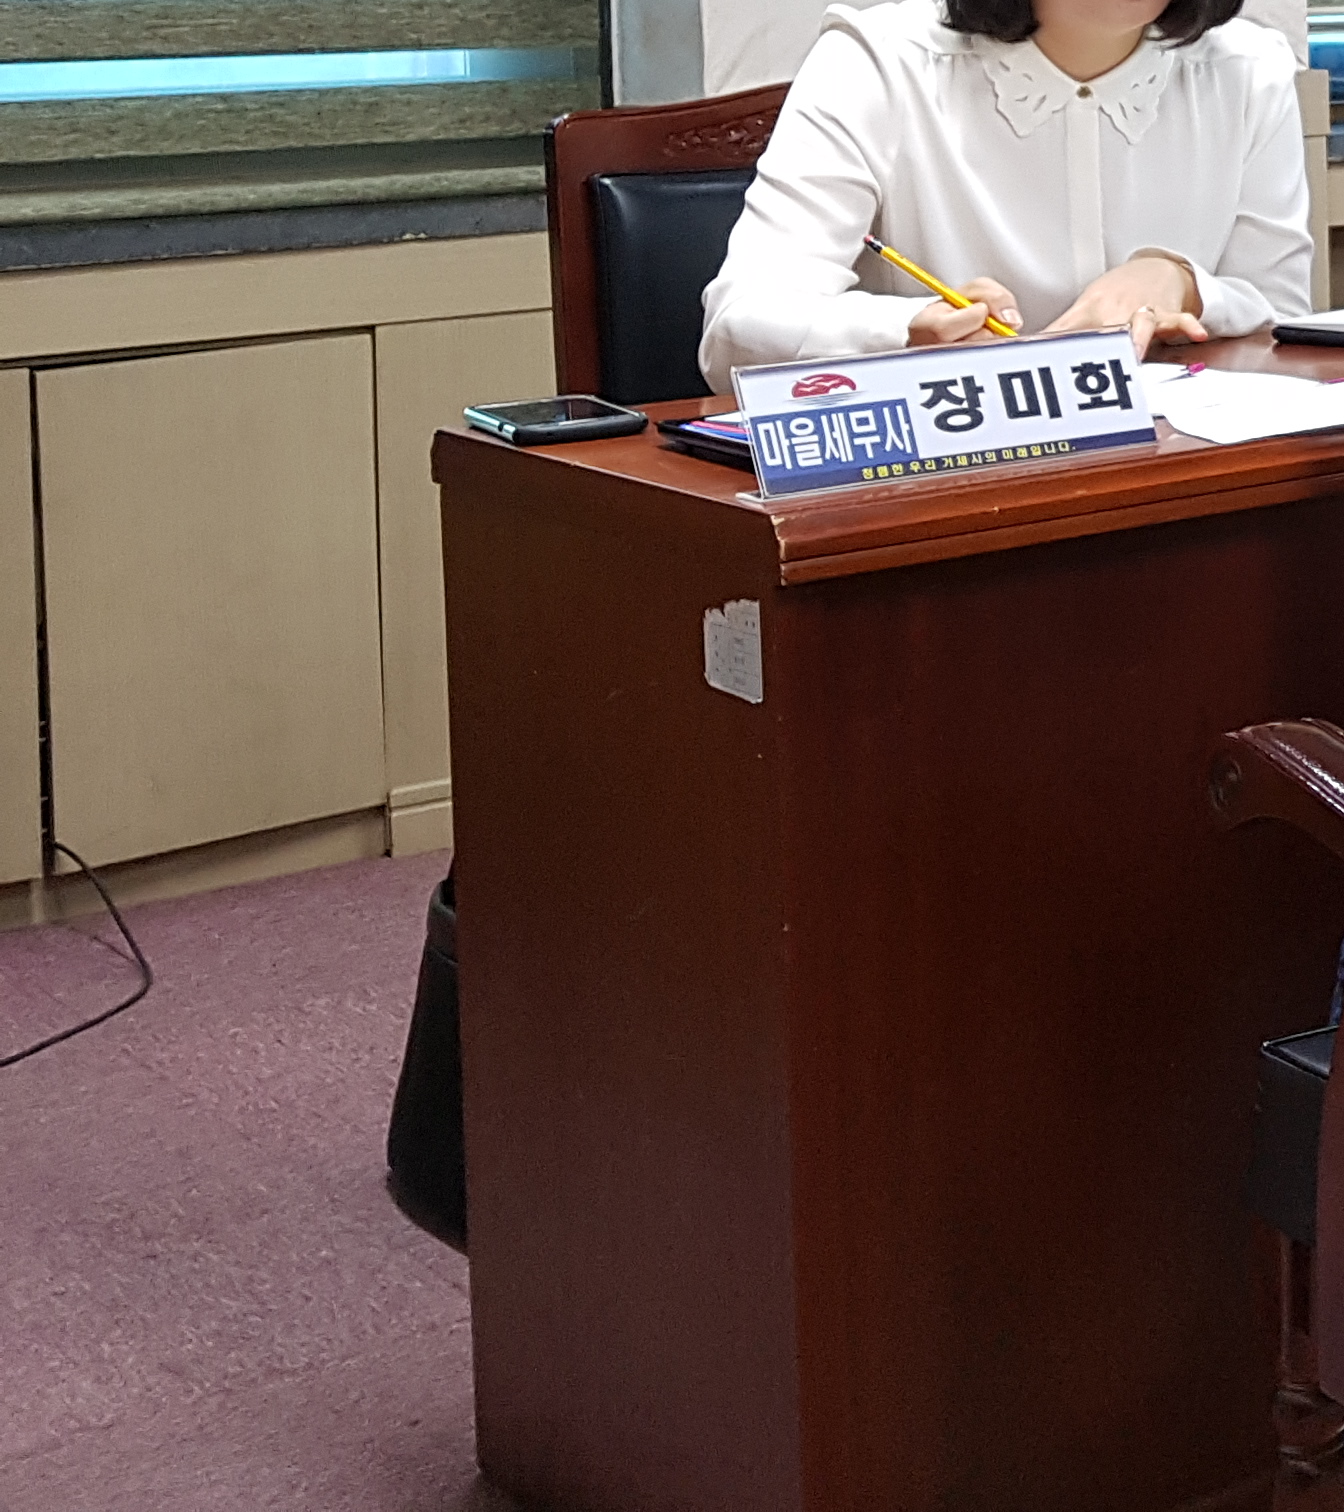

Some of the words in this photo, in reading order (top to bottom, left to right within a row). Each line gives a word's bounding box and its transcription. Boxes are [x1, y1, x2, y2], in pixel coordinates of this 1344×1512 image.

[918, 359, 1133, 434] 장미화
[756, 407, 913, 471] 마을세무사
[909, 459, 937, 474] 우리
[942, 451, 997, 469] 거제시의
